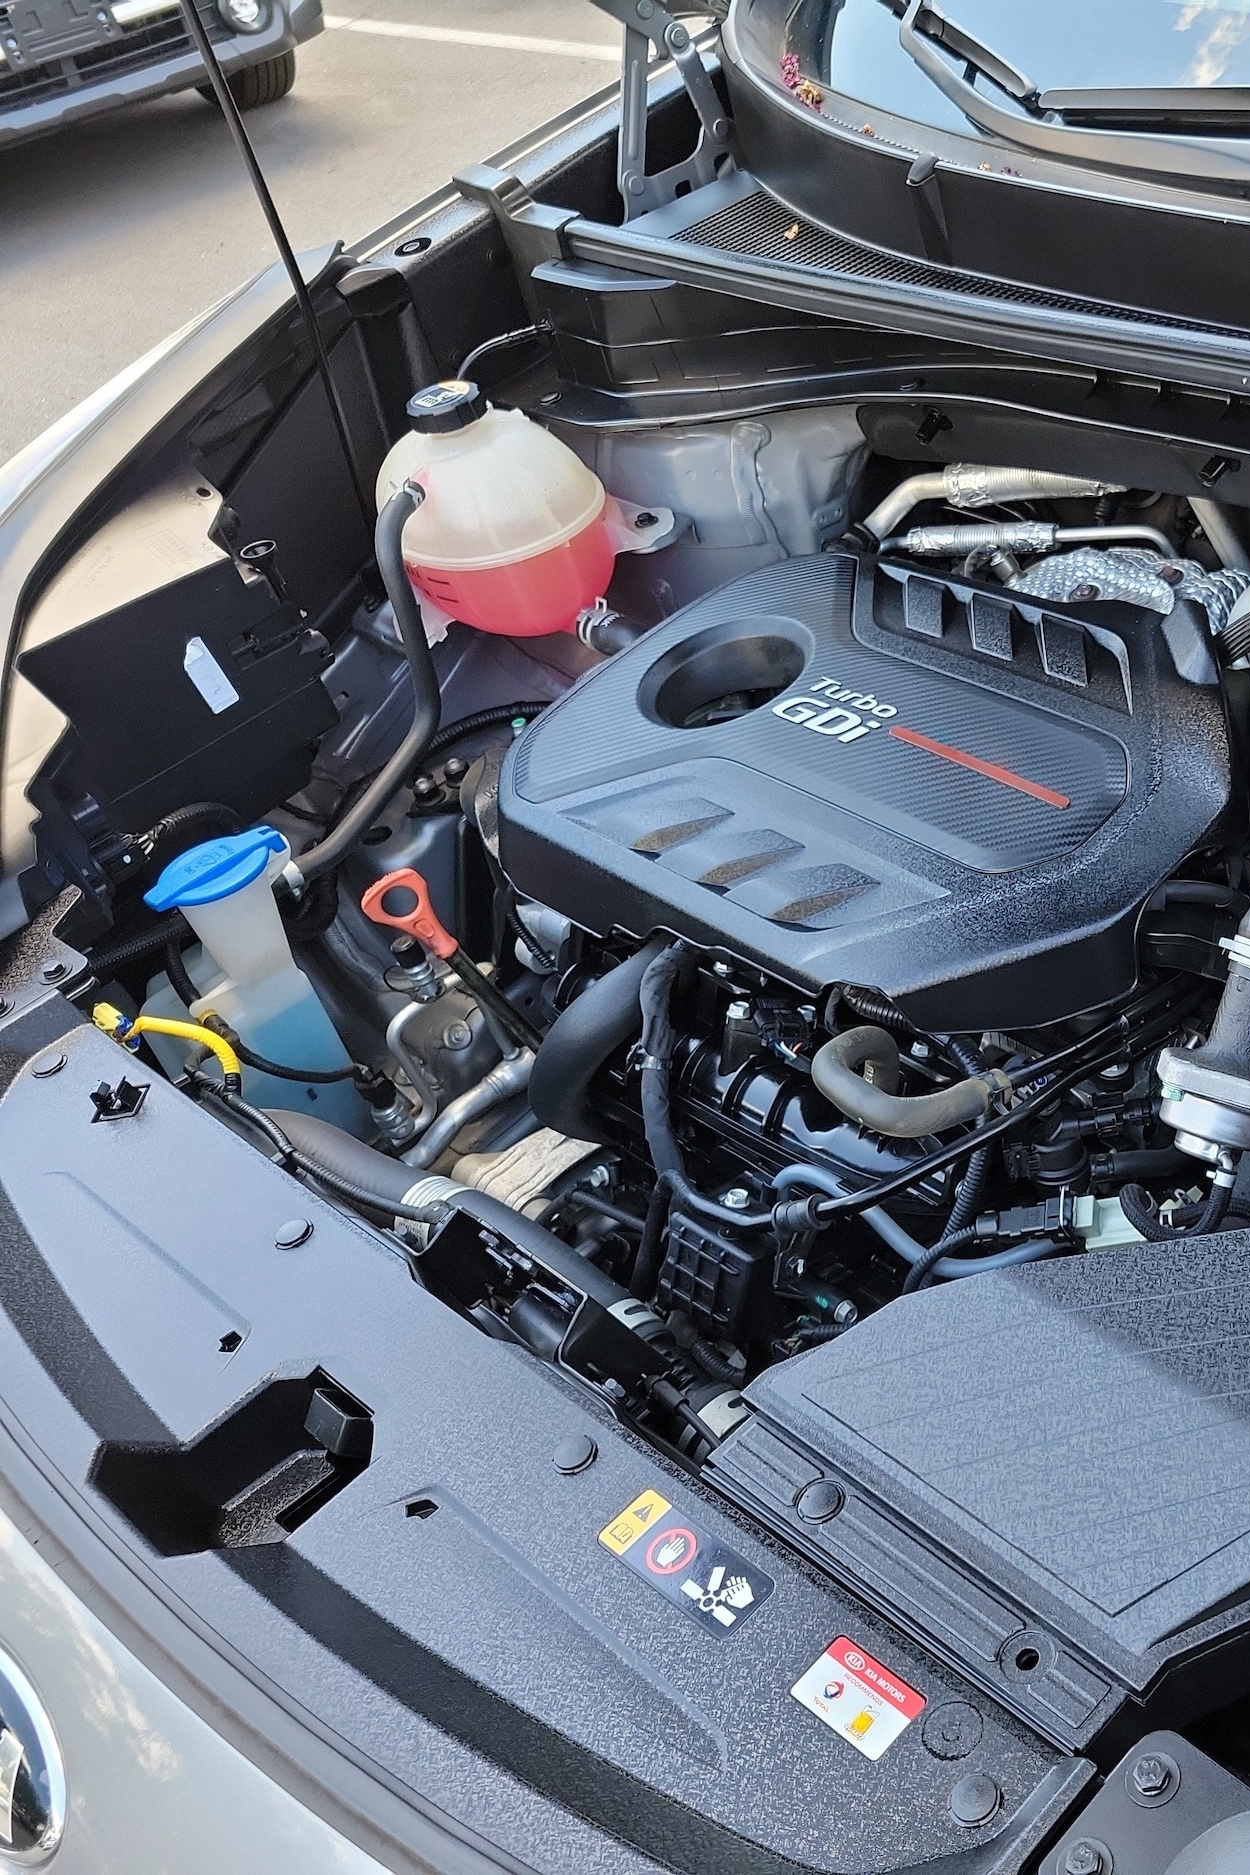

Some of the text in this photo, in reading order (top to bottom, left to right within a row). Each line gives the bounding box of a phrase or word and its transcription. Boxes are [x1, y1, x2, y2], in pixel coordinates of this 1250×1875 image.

[810, 675, 898, 718] Turbo
[771, 696, 882, 743] GDi
[843, 1672, 884, 1707] RECOMMENDS
[847, 1654, 907, 1704] KIA KIA MOTORS
[812, 1695, 830, 1714] TOTAL
